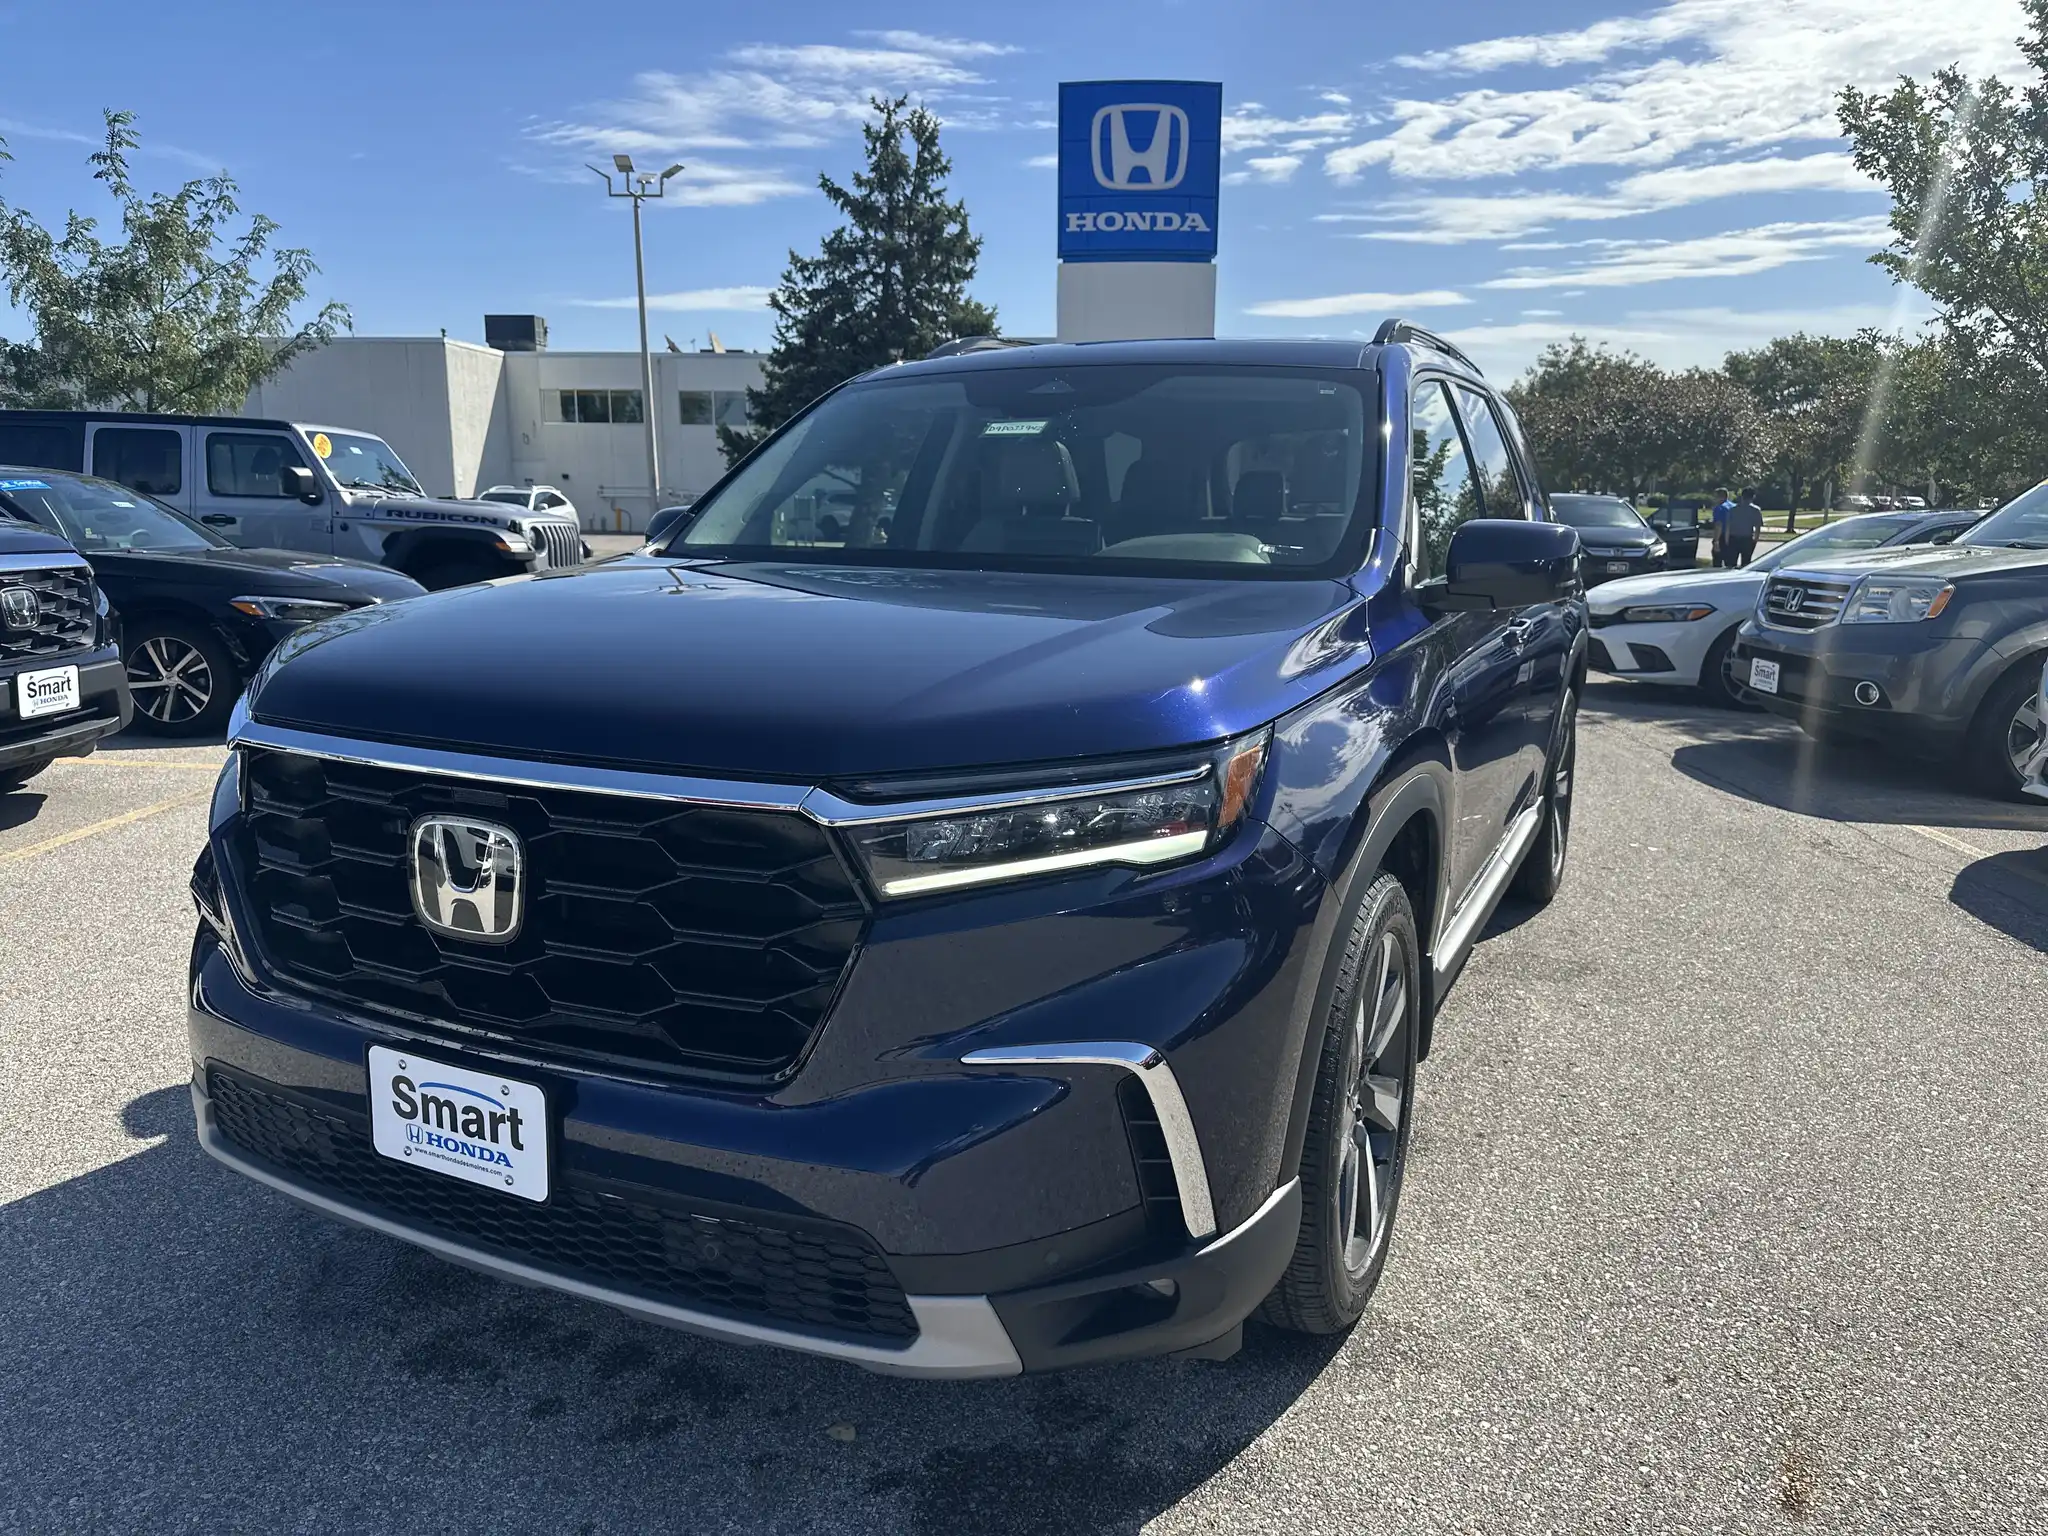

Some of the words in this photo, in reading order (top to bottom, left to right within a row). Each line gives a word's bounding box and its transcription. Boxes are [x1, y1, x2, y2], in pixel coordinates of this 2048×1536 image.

[1066, 212, 1211, 232] HONDA
[386, 509, 498, 525] RUBICON
[1754, 664, 1776, 682] Smart
[27, 676, 72, 699] Smart
[391, 1075, 524, 1151] Smart
[414, 1146, 503, 1177] www.smarthondadesmoines.com
[425, 1131, 514, 1169] HONDA
